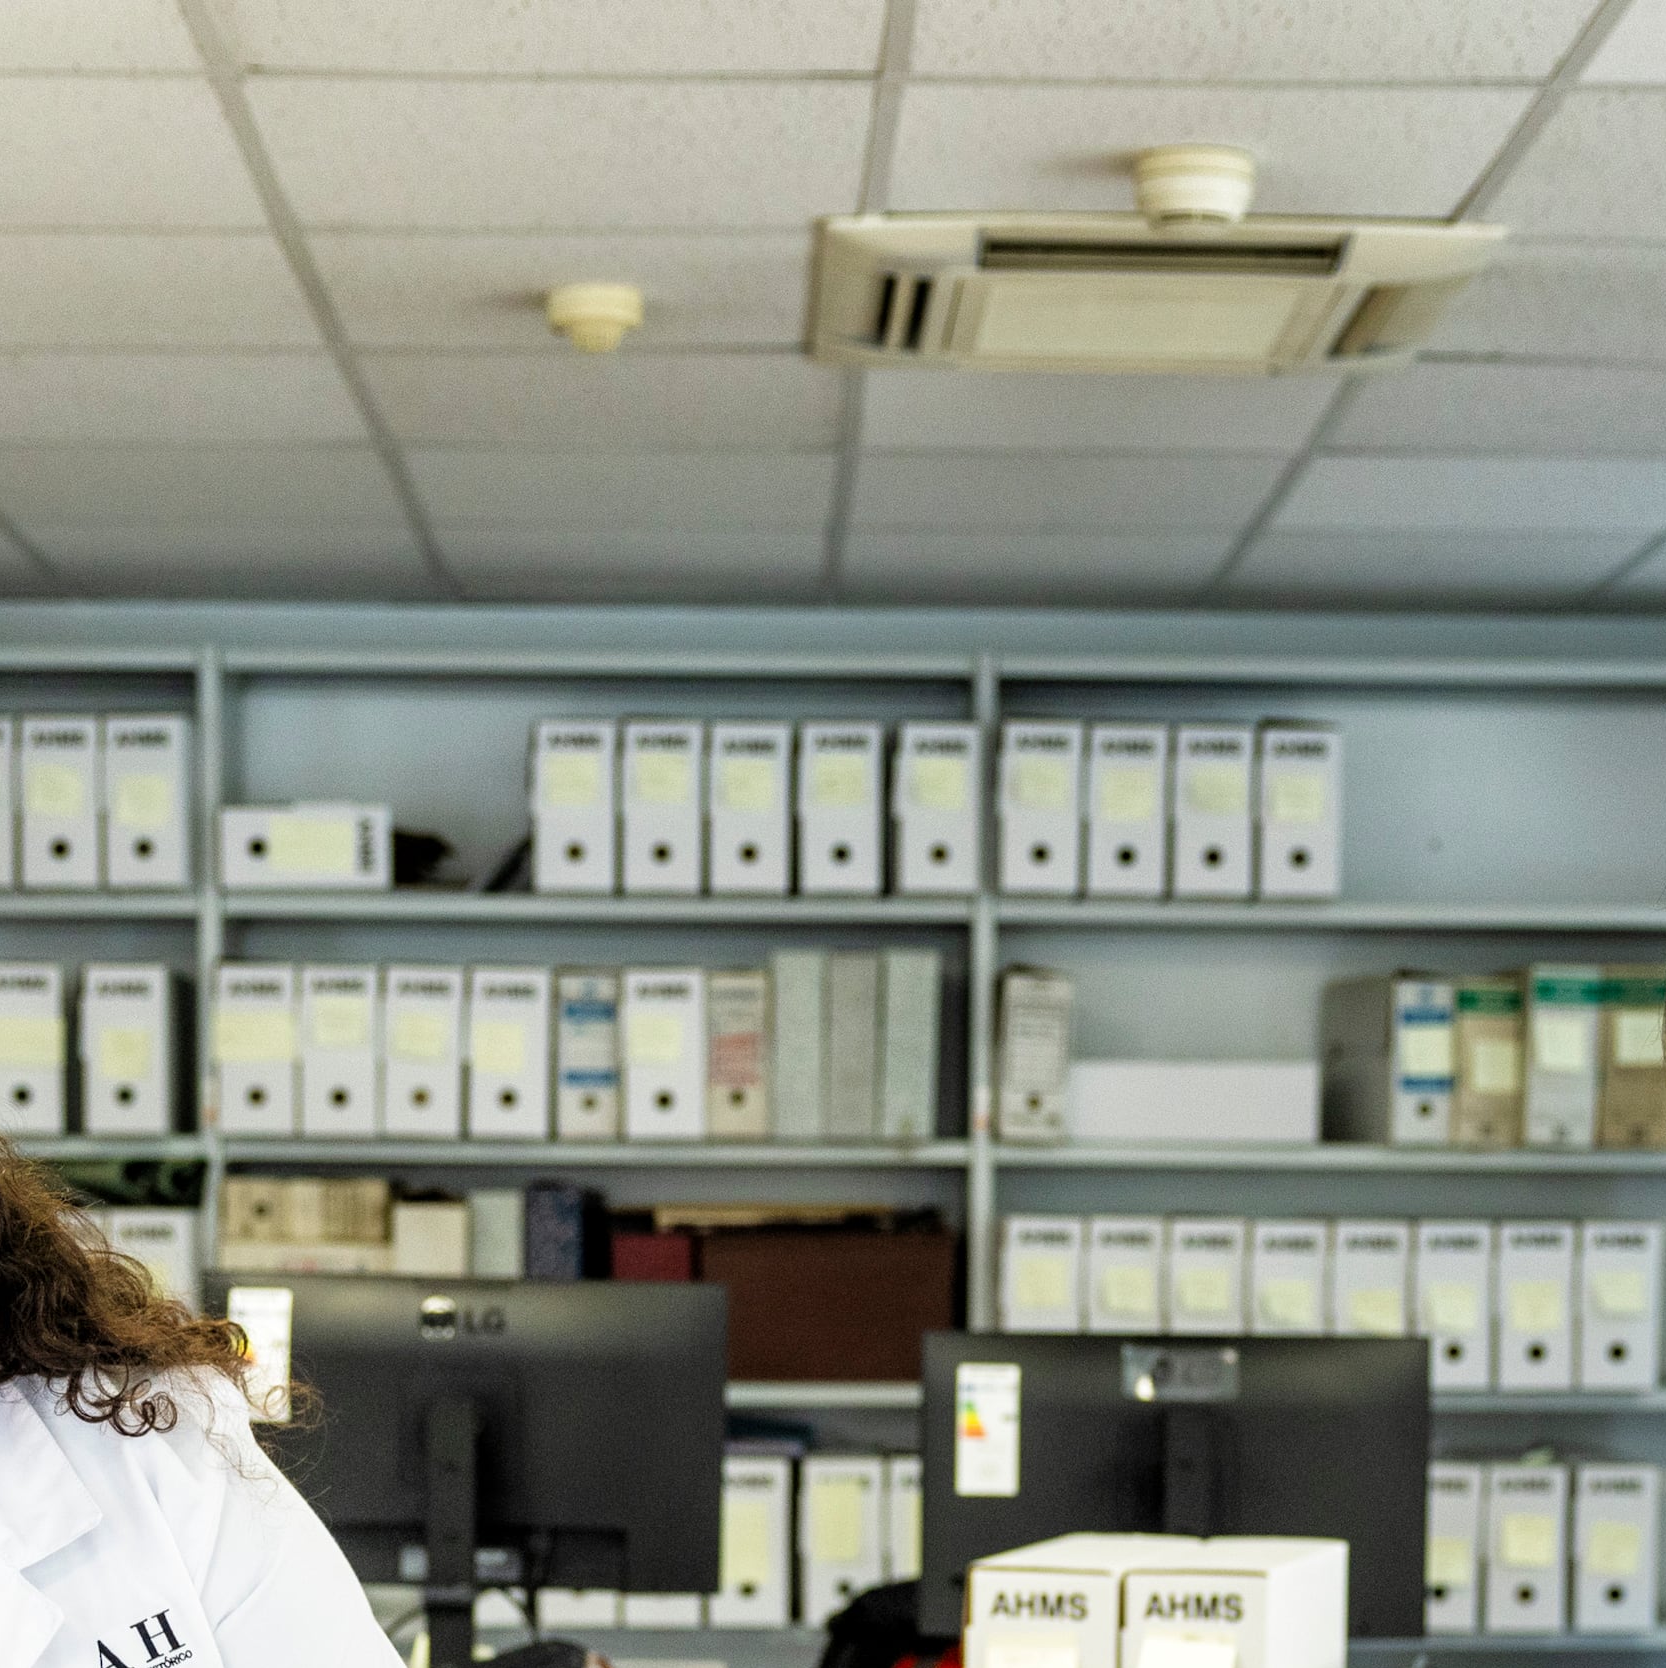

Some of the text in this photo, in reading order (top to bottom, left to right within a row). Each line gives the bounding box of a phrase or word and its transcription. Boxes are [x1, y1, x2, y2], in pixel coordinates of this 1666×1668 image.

[463, 1307, 506, 1335] LG
[990, 1590, 1089, 1621] AHMS
[1144, 1591, 1244, 1623] AHMS
